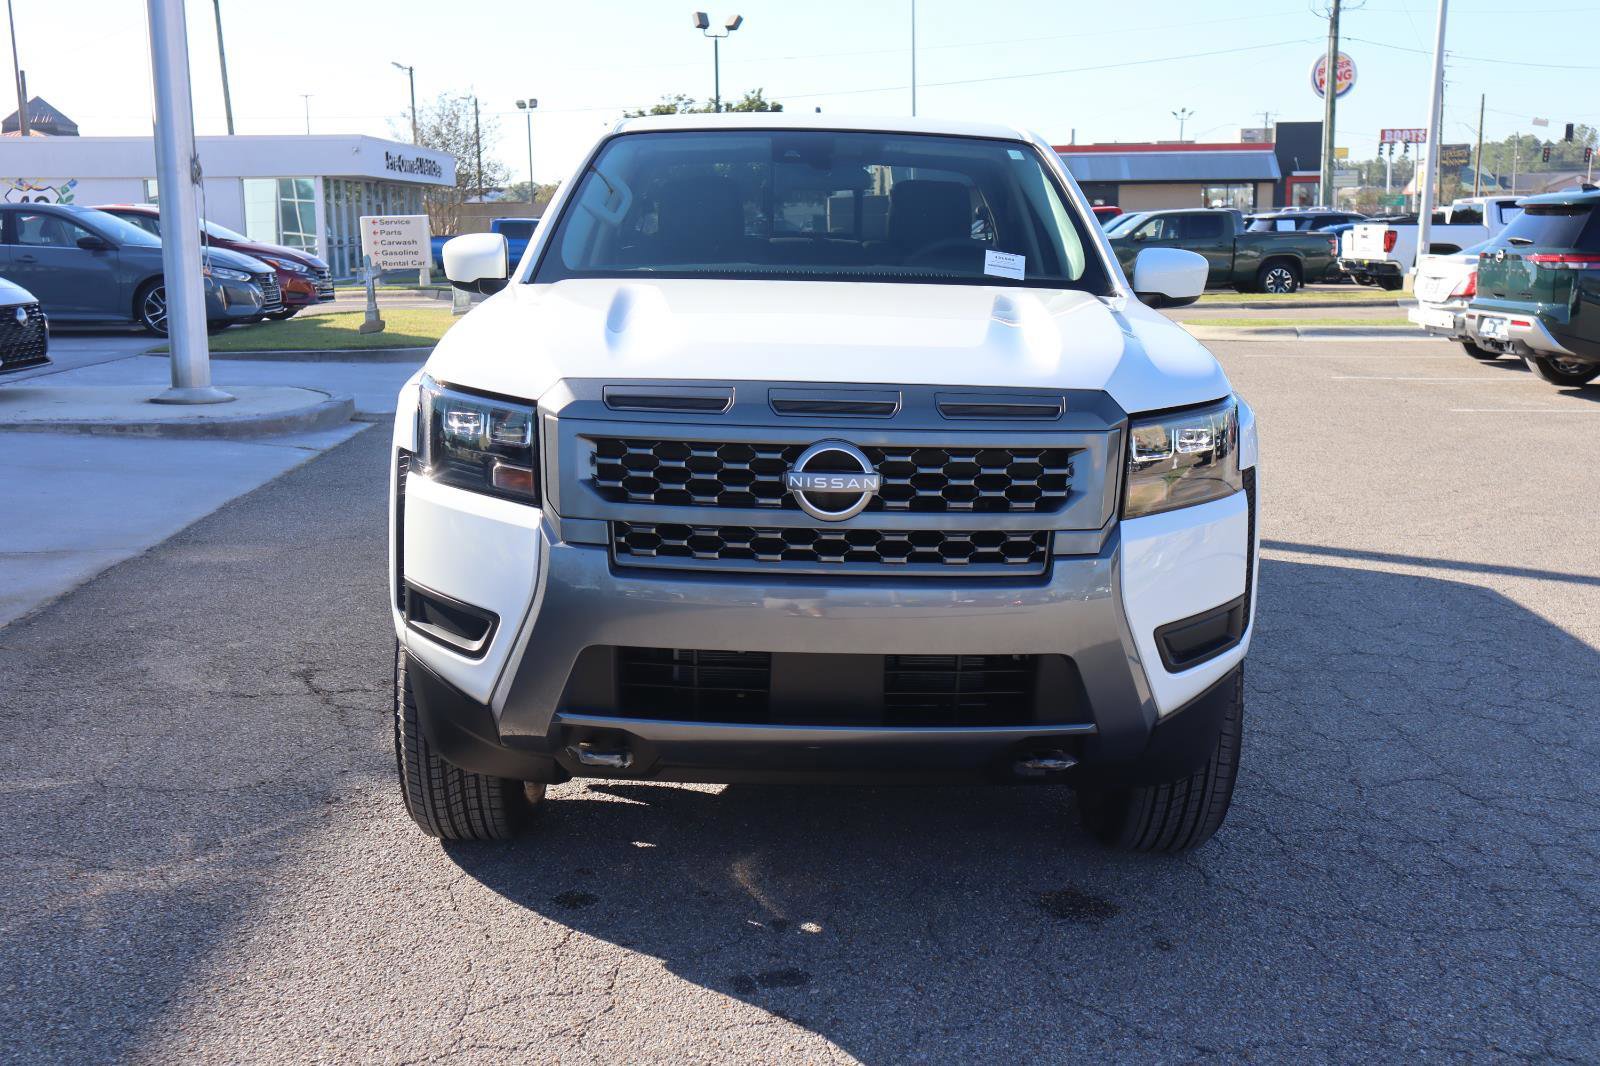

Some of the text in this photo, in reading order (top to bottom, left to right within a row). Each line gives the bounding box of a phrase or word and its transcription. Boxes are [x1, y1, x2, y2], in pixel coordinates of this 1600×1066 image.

[1319, 69, 1353, 88] KNG
[1385, 129, 1426, 143] BOOTS
[381, 249, 420, 257] Gasoline
[789, 475, 877, 490] NISSAN
